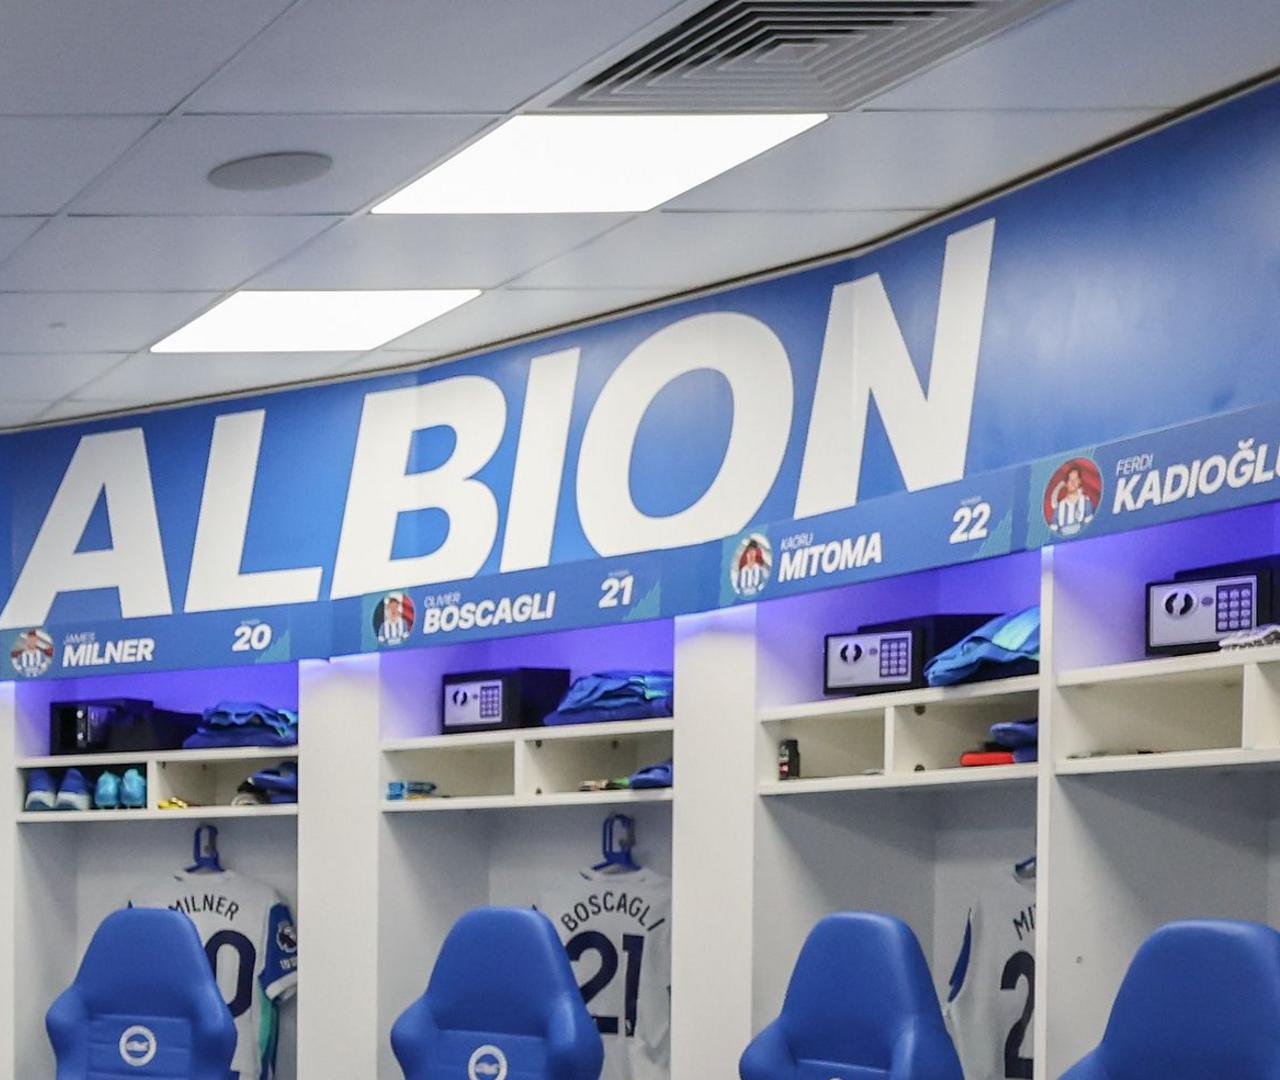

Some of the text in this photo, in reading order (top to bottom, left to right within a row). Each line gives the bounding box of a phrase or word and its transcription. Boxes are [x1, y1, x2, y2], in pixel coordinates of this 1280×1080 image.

[1112, 437, 1280, 515] KADIOĞL
[1115, 452, 1154, 476] FERDI
[949, 502, 991, 545] 22
[778, 531, 882, 583] MITOMA
[423, 590, 557, 635] BOSCAGLI
[598, 575, 634, 608] 21
[62, 637, 155, 668] MILNER
[231, 623, 272, 652] 20
[560, 891, 665, 933] BOSCAGLI
[565, 930, 644, 1037] 21
